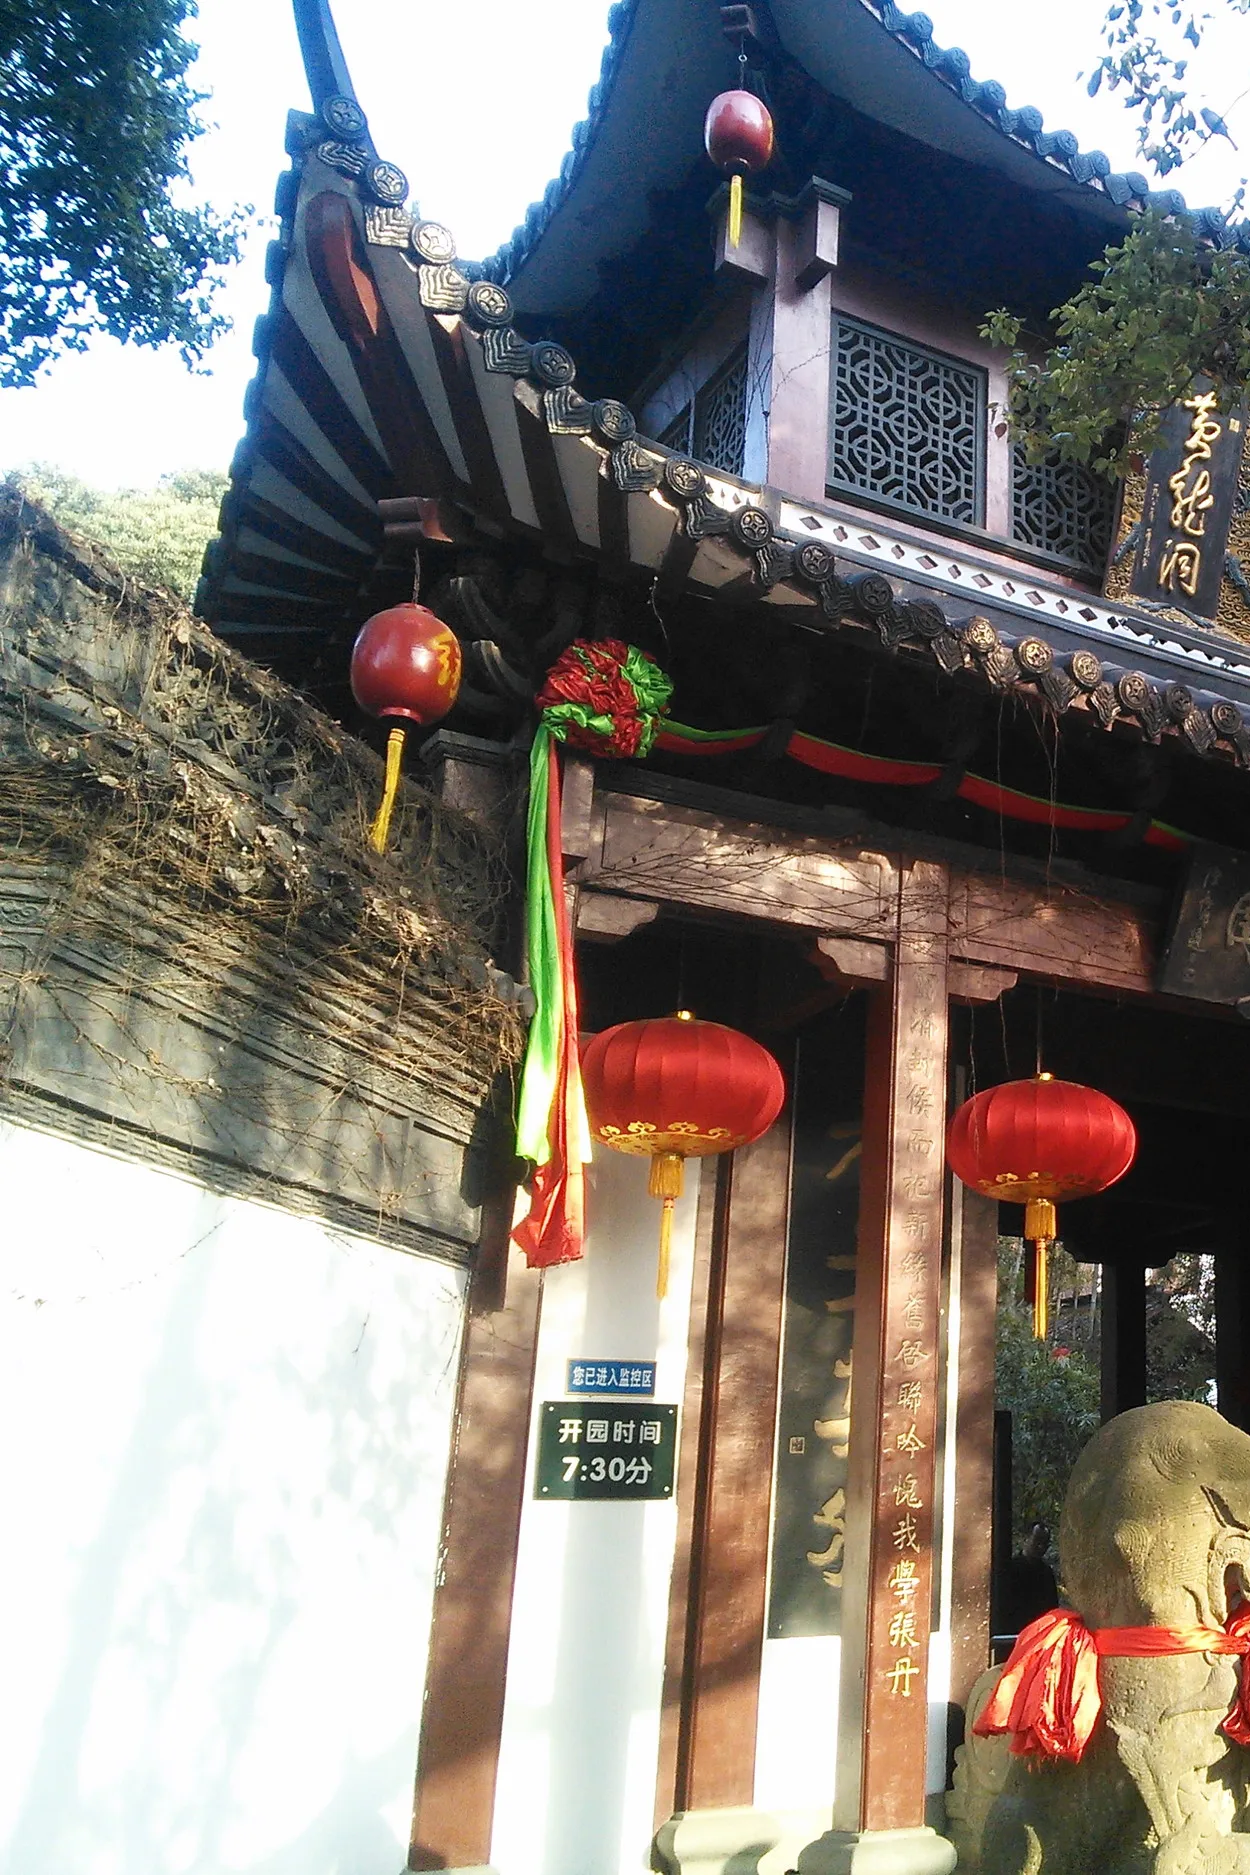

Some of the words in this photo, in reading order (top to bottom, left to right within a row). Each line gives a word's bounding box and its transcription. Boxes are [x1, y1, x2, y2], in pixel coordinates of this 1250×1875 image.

[572, 1366, 652, 1388] 您已进入监控区
[558, 1418, 662, 1445] 开园时间
[561, 1456, 653, 1485] 7:30分
